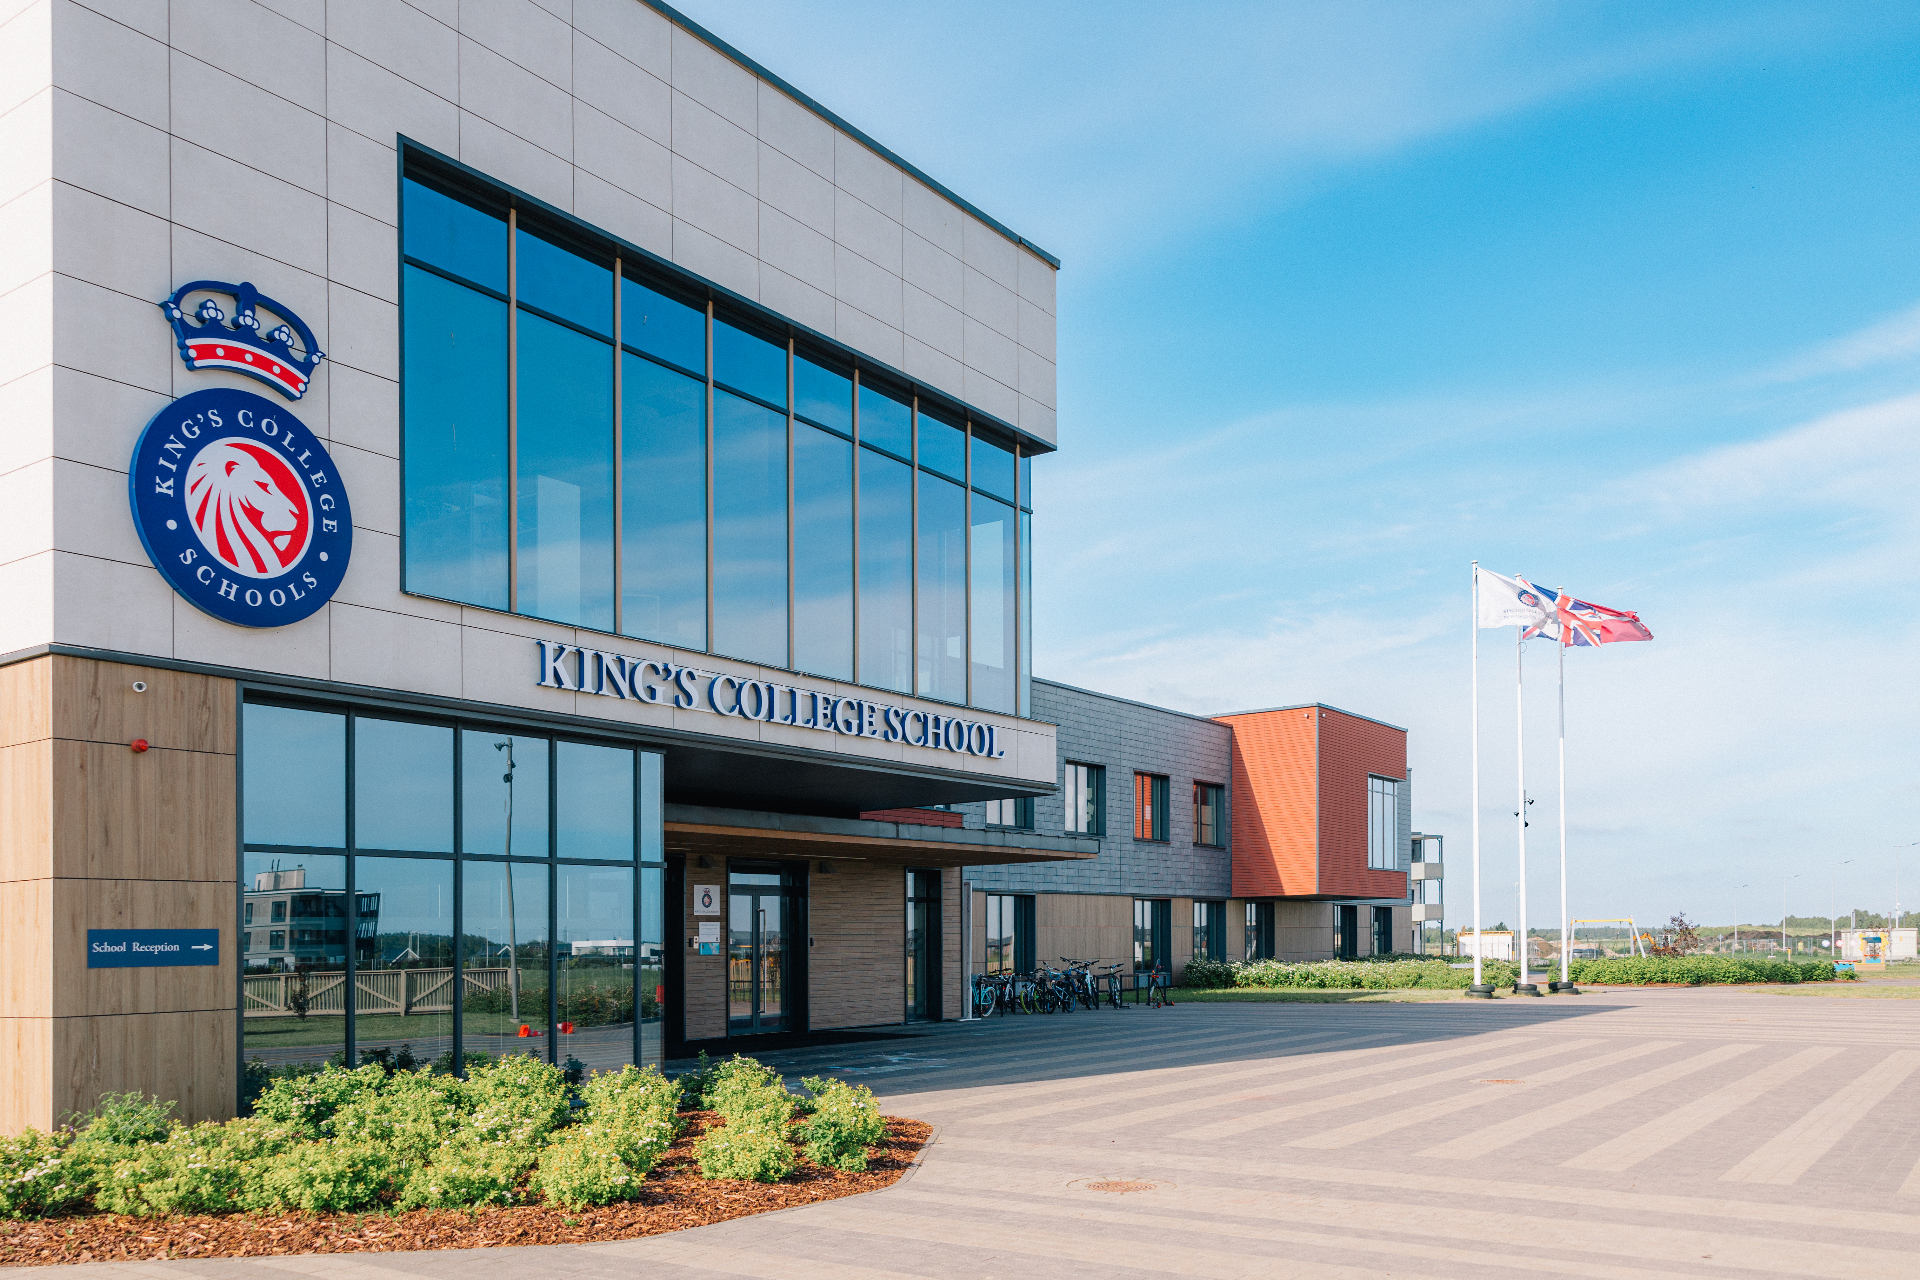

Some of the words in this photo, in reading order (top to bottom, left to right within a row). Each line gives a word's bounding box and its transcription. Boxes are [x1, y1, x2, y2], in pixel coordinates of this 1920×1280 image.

[155, 408, 223, 498] KING'S
[237, 409, 338, 533] COLLEGE
[179, 548, 318, 607] SCHOOLS
[536, 640, 698, 710] KING'S
[708, 675, 882, 739] COLLEGE
[884, 706, 1006, 759] SCHOOL
[92, 941, 127, 953] School
[132, 941, 180, 954] Reception
